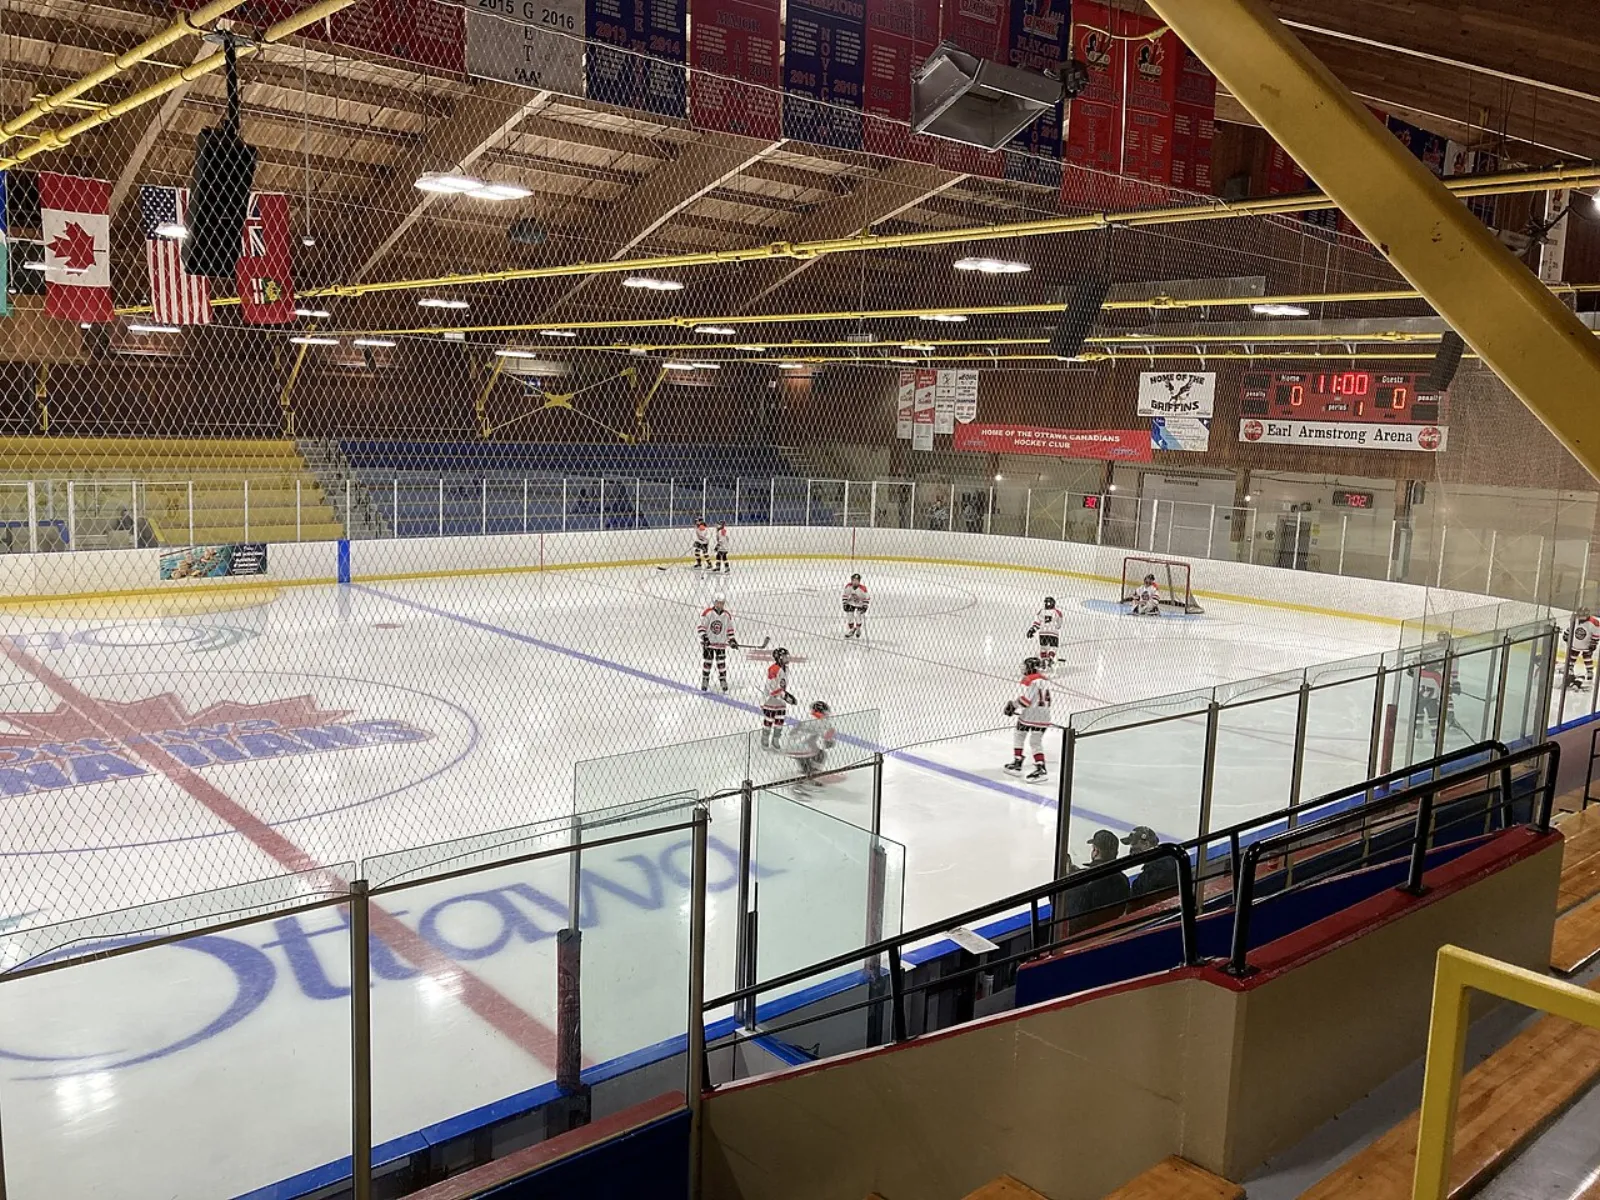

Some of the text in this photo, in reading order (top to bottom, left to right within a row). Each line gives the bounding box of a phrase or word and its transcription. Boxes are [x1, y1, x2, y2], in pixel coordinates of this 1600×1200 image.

[541, 9, 575, 30] 2016
[649, 35, 681, 55] 2014
[1149, 373, 1206, 386] HOME OF THE
[1319, 373, 1369, 395] 11:00
[1382, 375, 1404, 384] Guests
[1290, 385, 1303, 406] 0
[1393, 388, 1406, 410] 0
[1150, 399, 1200, 412] GRIFFINS
[1328, 403, 1347, 411] period
[1358, 401, 1364, 416] 1
[981, 429, 1003, 437] HOME
[1017, 430, 1033, 438] THE
[1034, 431, 1068, 441] OTTAWA
[1069, 434, 1121, 443] CANADIANS
[1267, 424, 1293, 437] Earl
[1298, 425, 1367, 444] Armstrong
[1373, 428, 1413, 442] Arena
[1014, 438, 1072, 449] HOCKEY CLUB
